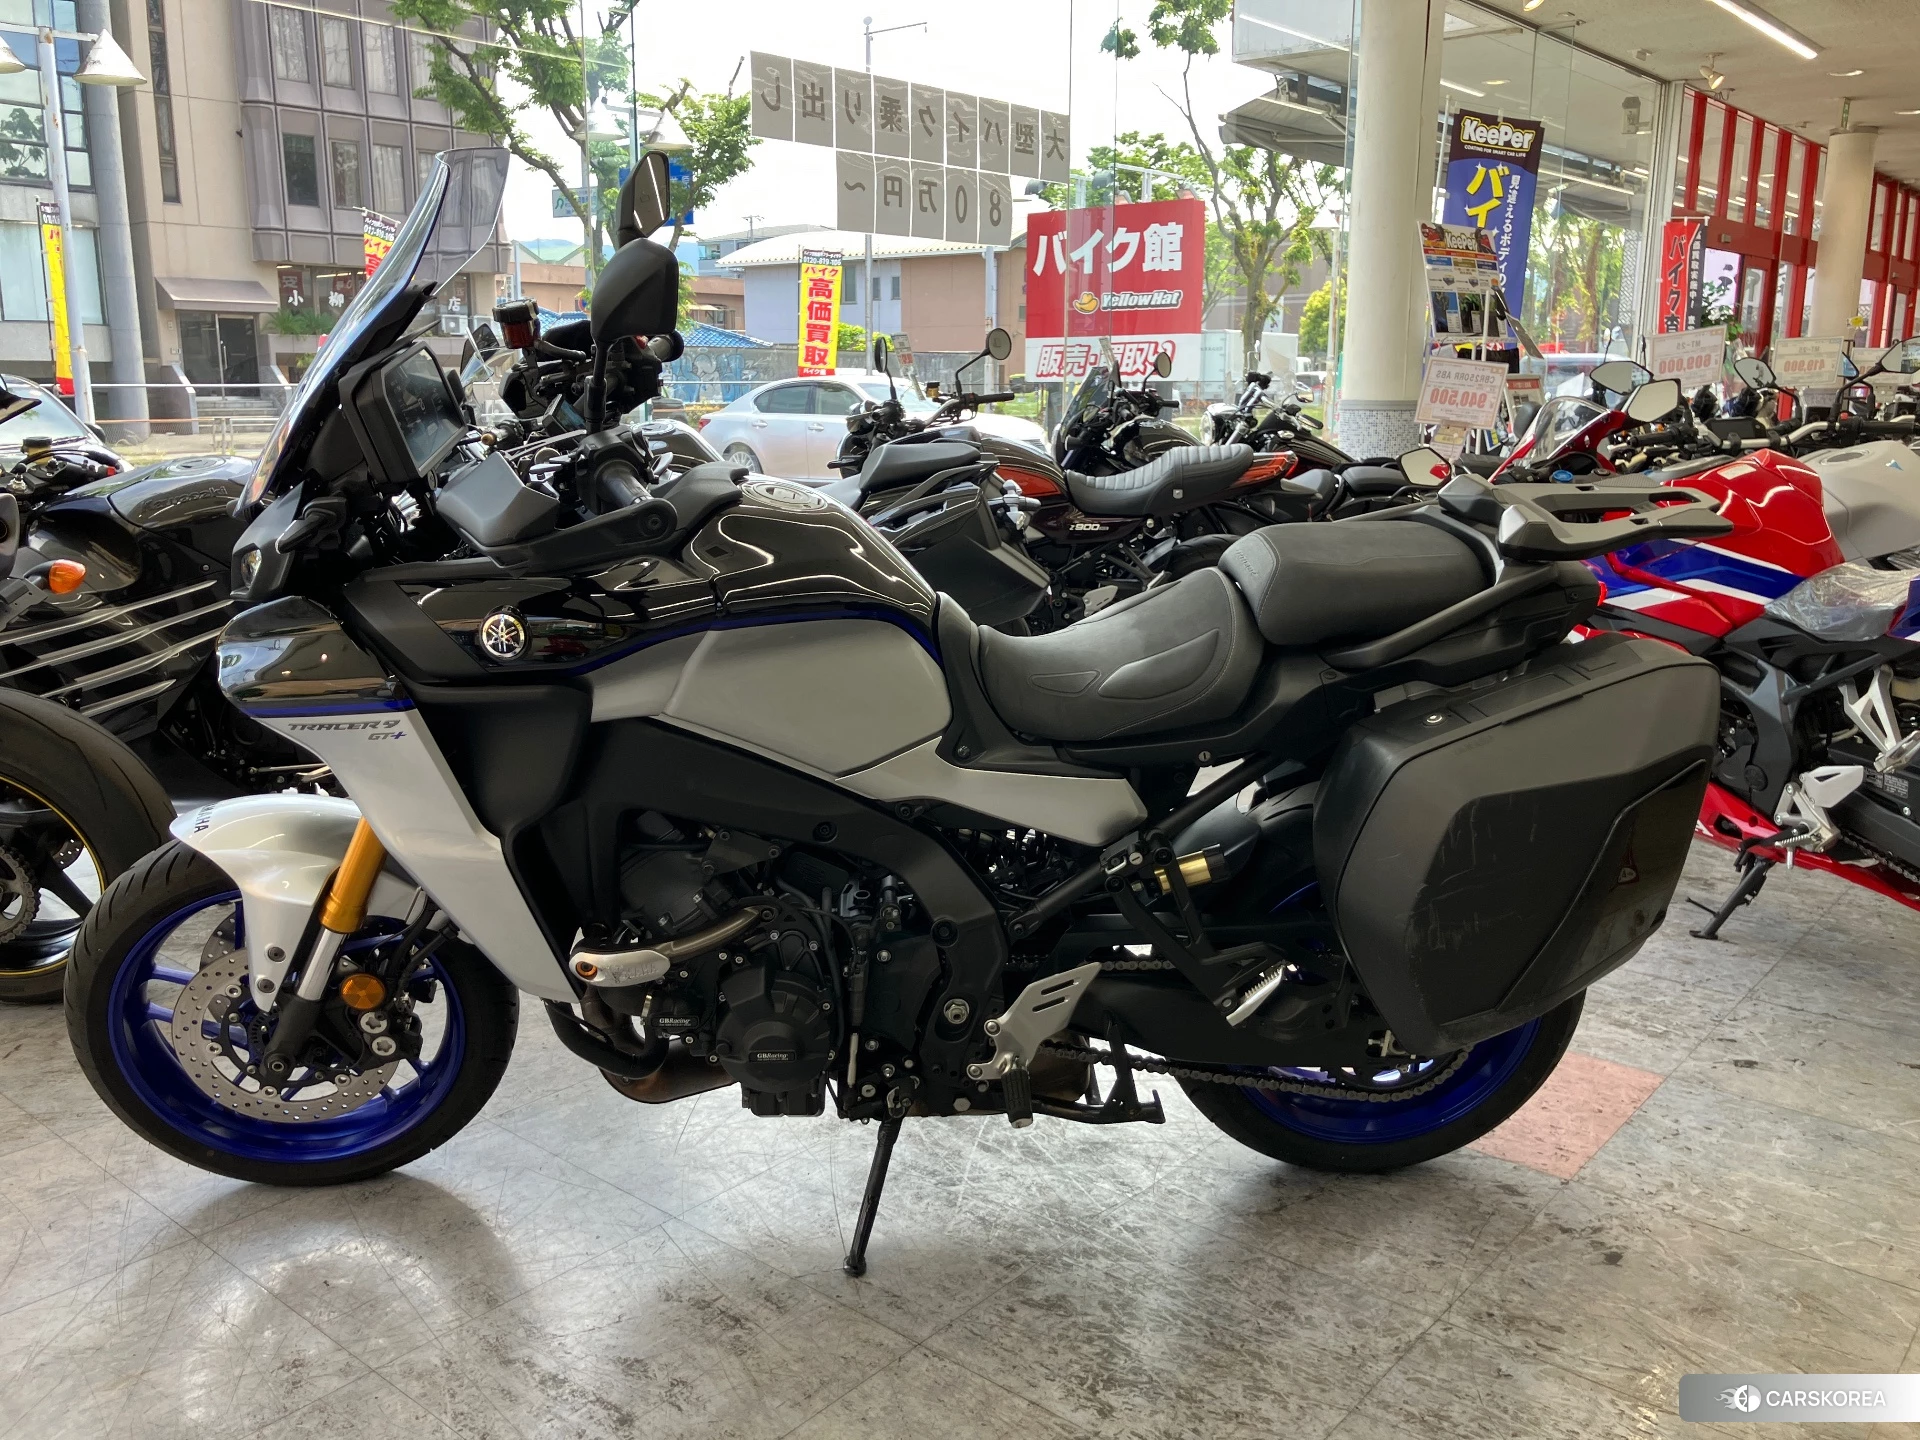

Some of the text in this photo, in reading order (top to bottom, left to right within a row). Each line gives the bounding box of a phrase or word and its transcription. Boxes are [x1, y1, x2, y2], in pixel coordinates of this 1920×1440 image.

[1461, 117, 1534, 150] KeePer
[1032, 221, 1184, 277] バイク館
[1497, 174, 1521, 292] 見違えるボディの
[805, 266, 839, 277] バイク
[1102, 291, 1181, 311] YellowHat
[804, 277, 834, 366] 高価買取
[367, 731, 407, 741] GT+
